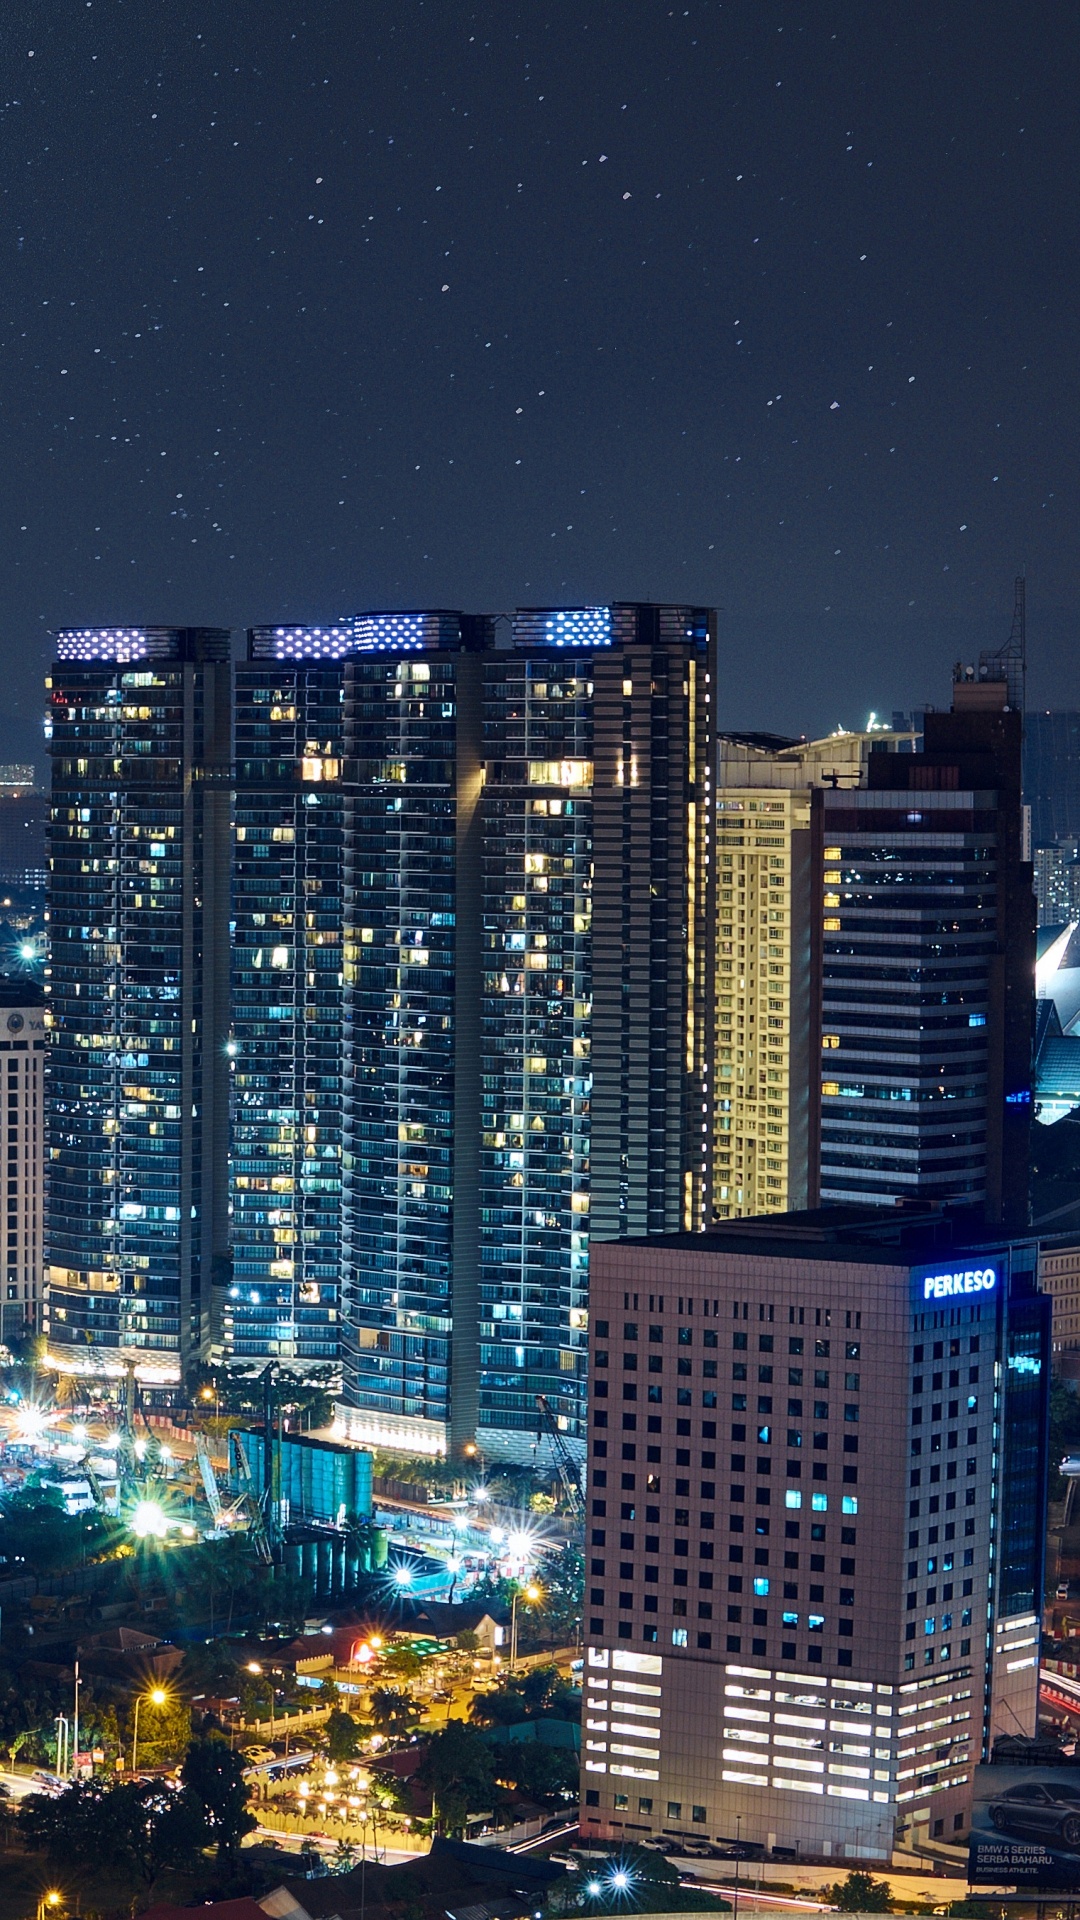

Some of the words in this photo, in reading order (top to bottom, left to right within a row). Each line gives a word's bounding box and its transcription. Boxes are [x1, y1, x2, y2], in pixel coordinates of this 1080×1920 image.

[924, 1268, 996, 1299] PERKESO
[977, 1845, 1003, 1854] BMW
[1003, 1845, 1010, 1854] 5
[1011, 1845, 1046, 1855] SERIES
[977, 1855, 1010, 1864] SERBA
[1011, 1855, 1055, 1865] BAHARU.
